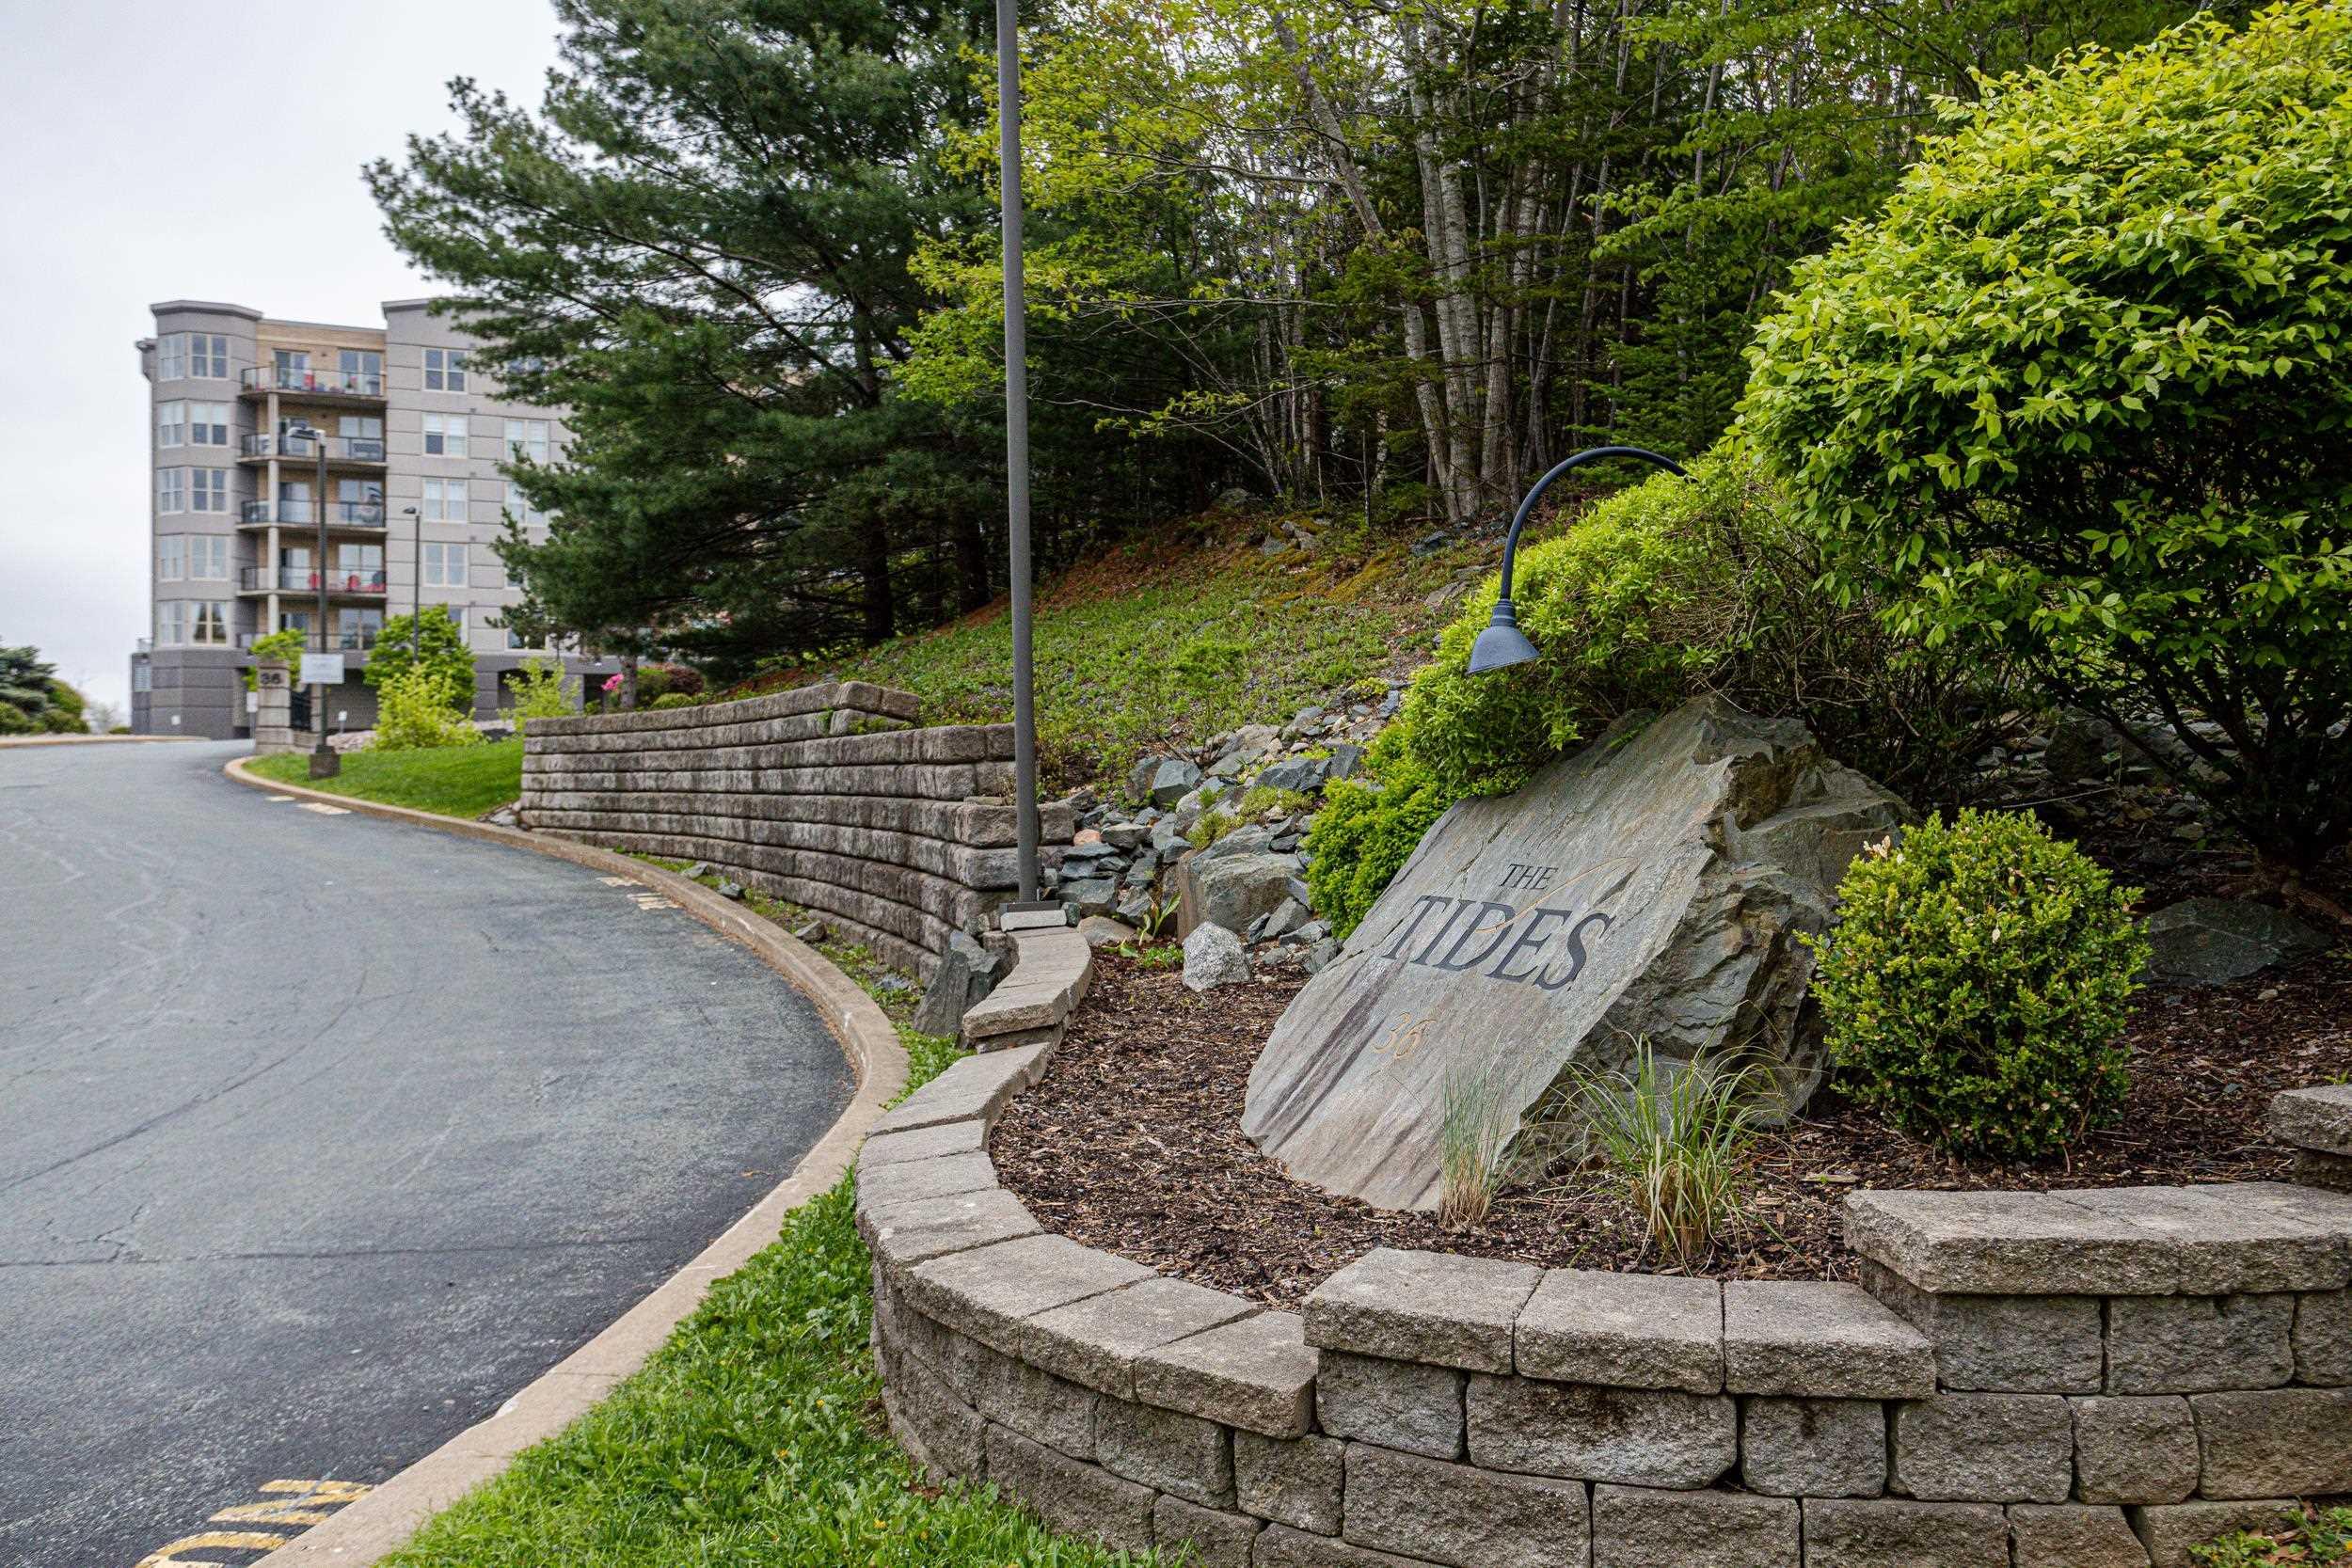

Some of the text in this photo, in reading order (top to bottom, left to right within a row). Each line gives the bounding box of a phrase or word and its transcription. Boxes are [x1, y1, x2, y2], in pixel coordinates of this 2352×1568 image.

[1499, 863, 1558, 890] THE
[1381, 895, 1616, 990] TIDES
[1372, 1011, 1438, 1060] 36
